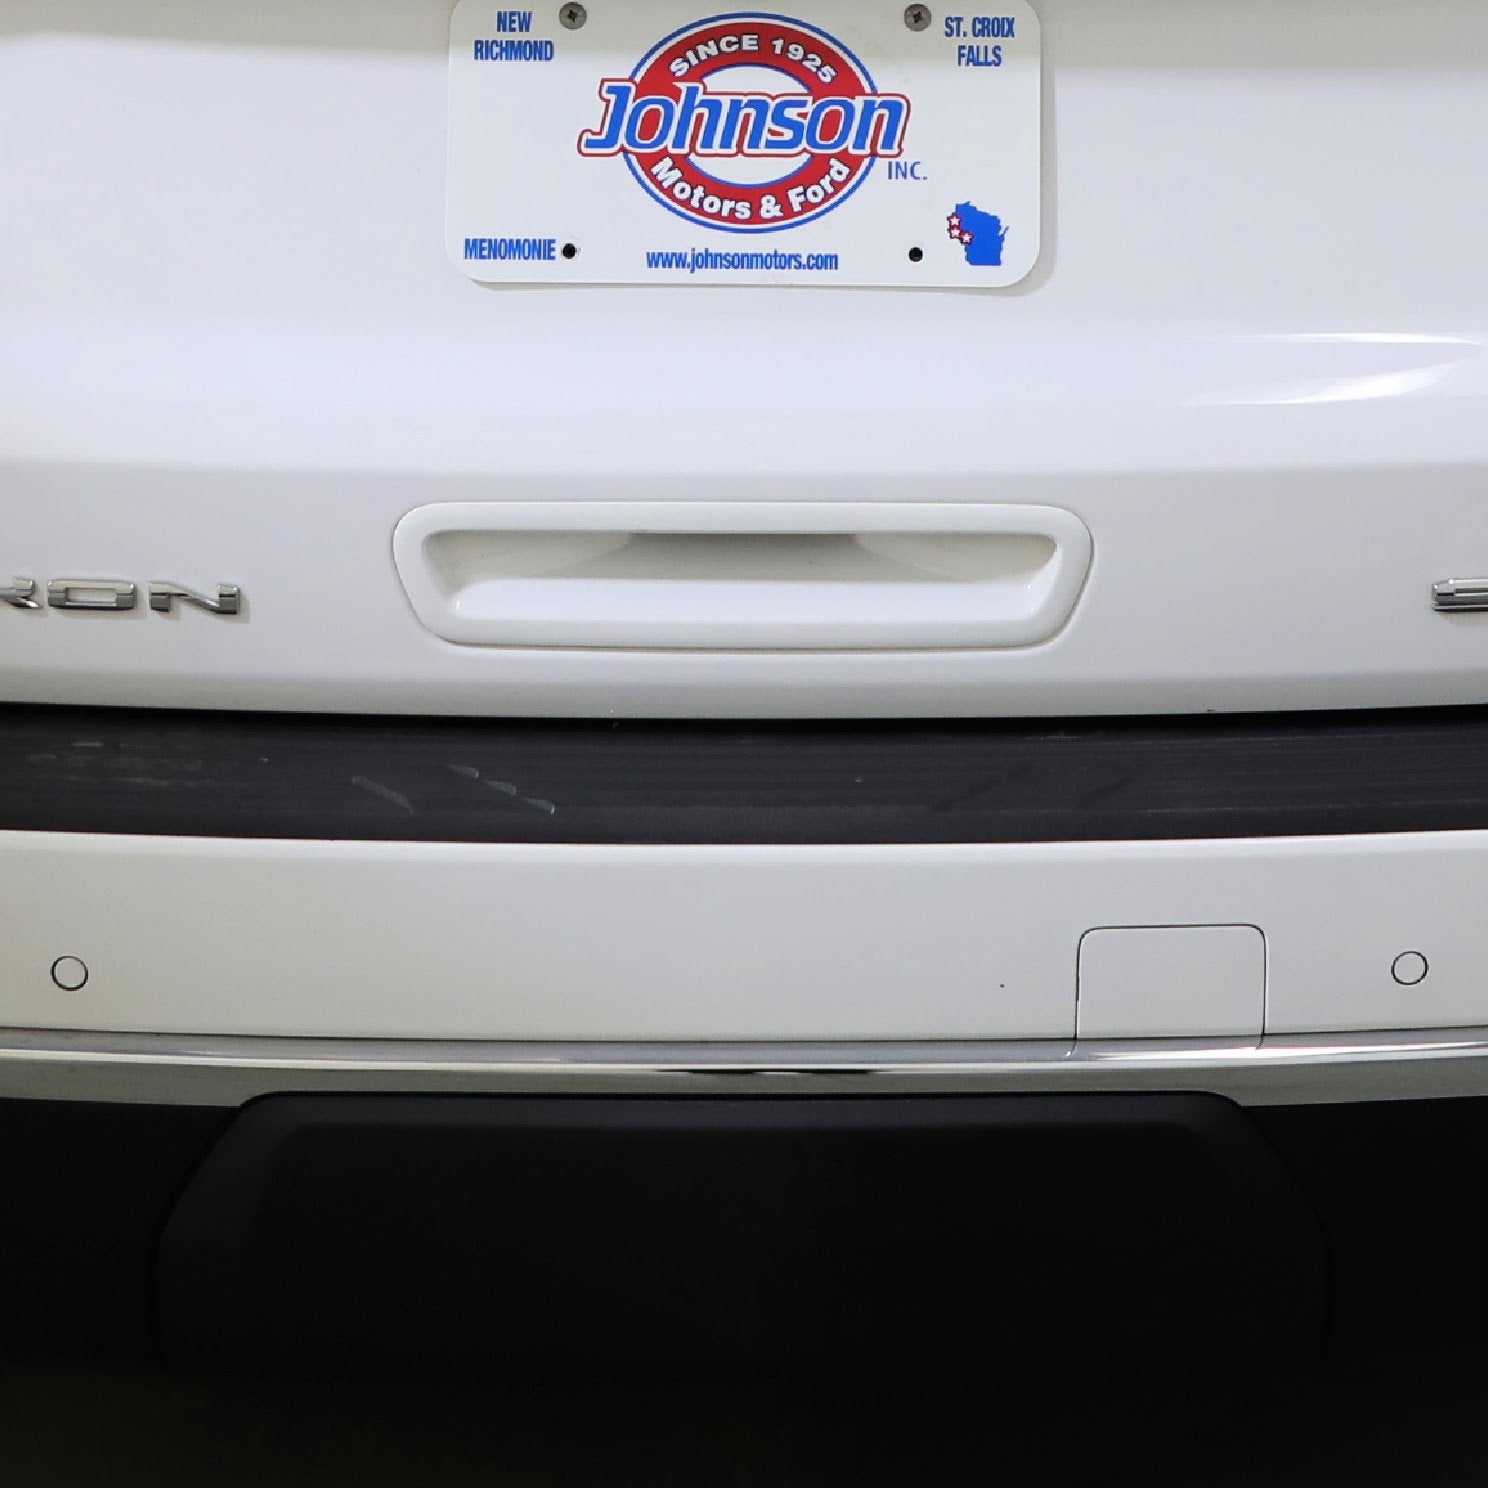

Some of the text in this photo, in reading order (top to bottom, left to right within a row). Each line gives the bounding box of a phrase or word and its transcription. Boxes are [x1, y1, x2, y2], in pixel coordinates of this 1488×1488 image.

[497, 11, 532, 32] NEW
[944, 16, 1015, 39] ST. CROIX
[474, 41, 554, 62] RICHMOND
[669, 33, 837, 84] SINCE 1925
[957, 45, 1002, 67] FALLS
[580, 79, 908, 156] Johnson
[888, 160, 928, 181] INC.
[650, 157, 852, 221] Motors & Ford
[464, 238, 556, 261] MENOMONIE
[646, 250, 839, 273] www.johnsonmotors.com
